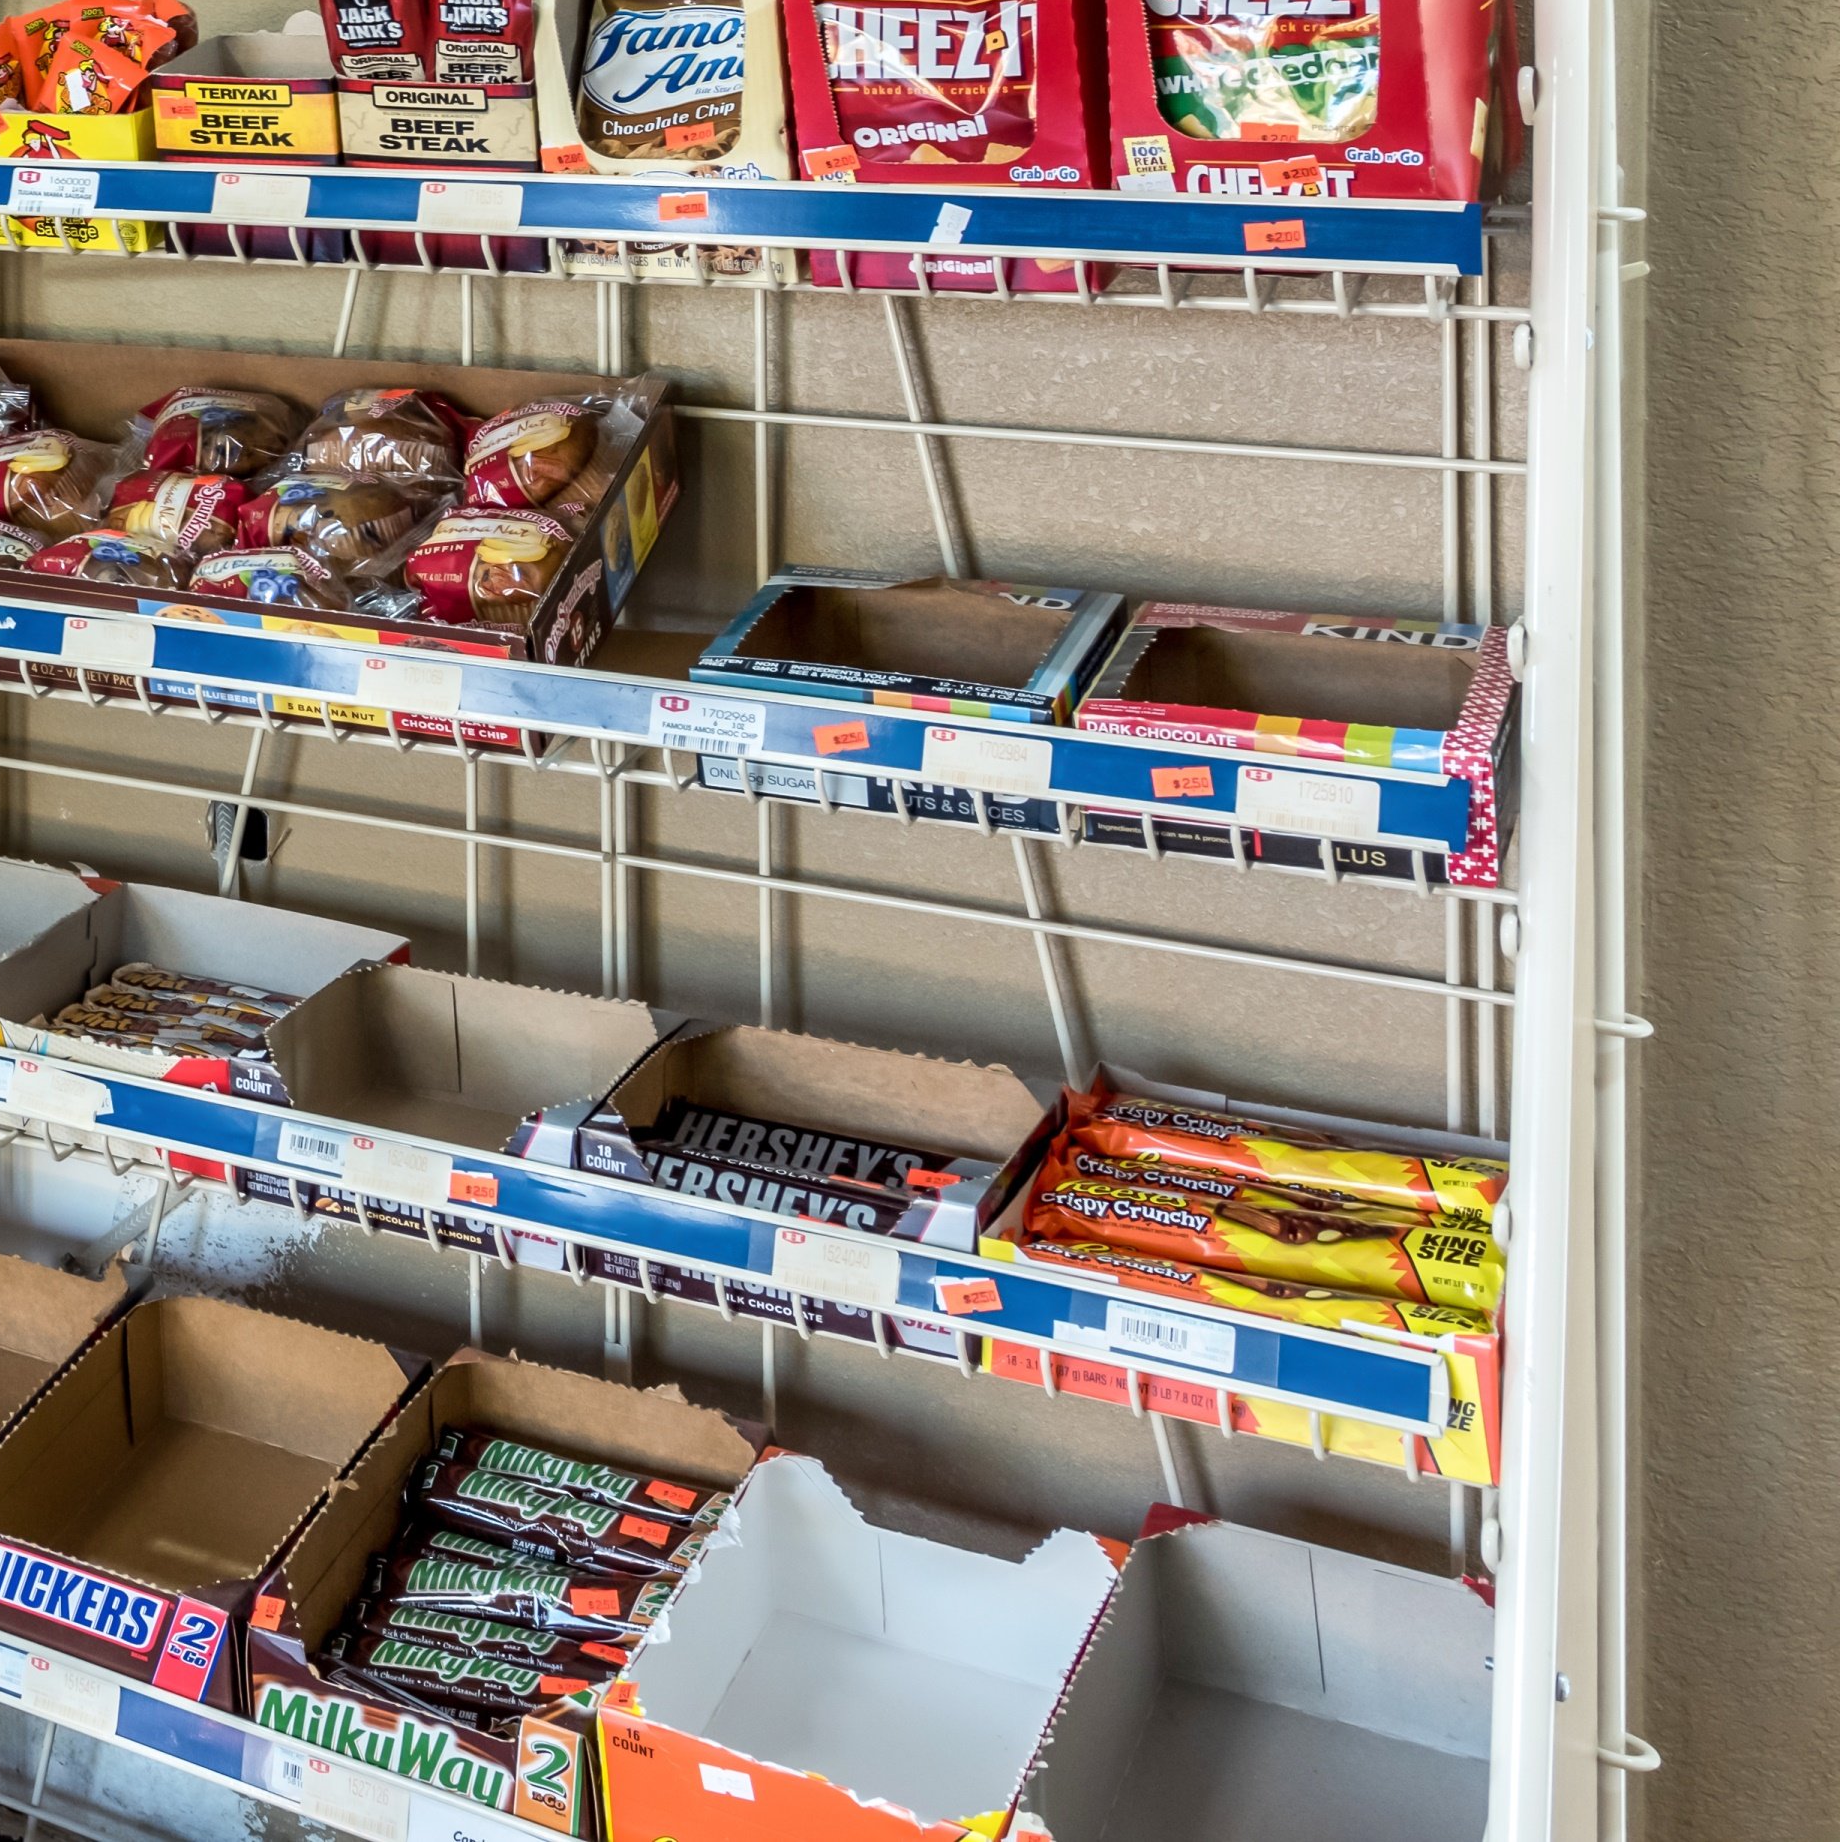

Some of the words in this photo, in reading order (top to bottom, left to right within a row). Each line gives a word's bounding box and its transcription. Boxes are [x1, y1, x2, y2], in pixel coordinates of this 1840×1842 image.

[339, 6, 389, 24] JACK
[440, 4, 508, 27] LINK'S
[337, 20, 403, 40] LINK'S
[445, 43, 508, 55] ORIGINAL
[350, 55, 408, 66] ORIGINAL
[446, 64, 508, 75] BEEF
[198, 87, 277, 101] TERIYAKI
[385, 90, 474, 106] ORIGINAL
[863, 84, 902, 96] baked
[201, 114, 279, 130] BEEF
[391, 118, 474, 135] BEEF
[602, 110, 689, 136] Chocolate
[695, 101, 735, 121] Chip
[190, 131, 294, 147] STEAK
[379, 135, 491, 154] STEAK
[1131, 145, 1166, 157] 100%
[1346, 148, 1382, 162] Grab
[1399, 151, 1422, 164] Go
[825, 156, 855, 168] $2.00
[1134, 156, 1167, 166] REAL
[1135, 164, 1168, 173] CHEESE
[50, 176, 91, 186] 1660000
[1010, 167, 1042, 180] Grab
[1058, 168, 1079, 181] Go
[1282, 166, 1318, 180] $2.00
[1266, 230, 1301, 243] $2.00
[1302, 622, 1480, 651] KIND
[792, 664, 860, 677] INGREDIENTS
[863, 672, 887, 680] YOU
[887, 675, 912, 683] CAN
[701, 707, 756, 723] 1702968
[478, 728, 508, 740] CHIP
[662, 721, 691, 731] FAMOUS
[693, 725, 715, 733] AMOS
[717, 728, 738, 737] CHOC
[1086, 721, 1132, 737] DARK
[1135, 726, 1237, 748] CHOCOLATE
[833, 731, 864, 745] $2.50
[750, 772, 764, 786] 5g
[767, 775, 817, 790] SUGAR
[1173, 777, 1209, 790] $2.50
[247, 1068, 260, 1081] 18
[235, 1077, 272, 1095] COUNT
[596, 1143, 612, 1157] 18
[675, 1111, 923, 1190] HERSHEY'S
[585, 1154, 627, 1175] COUNT
[1076, 1155, 1137, 1182] Crispy
[1143, 1168, 1236, 1198] Crunchy
[465, 1186, 494, 1199] $2.50
[1041, 1189, 1110, 1218] Crispy
[1113, 1199, 1208, 1232] Crunchy
[366, 1209, 420, 1231] CHOCOLATE
[437, 1227, 482, 1245] ALMONDS
[1421, 1233, 1487, 1258] KING
[1417, 1246, 1483, 1268] SIZE
[962, 1291, 996, 1305] $2.50
[173, 1615, 217, 1651] 2
[626, 1727, 641, 1741] 16
[612, 1736, 655, 1759] COUNT
[523, 1741, 569, 1793] 2
